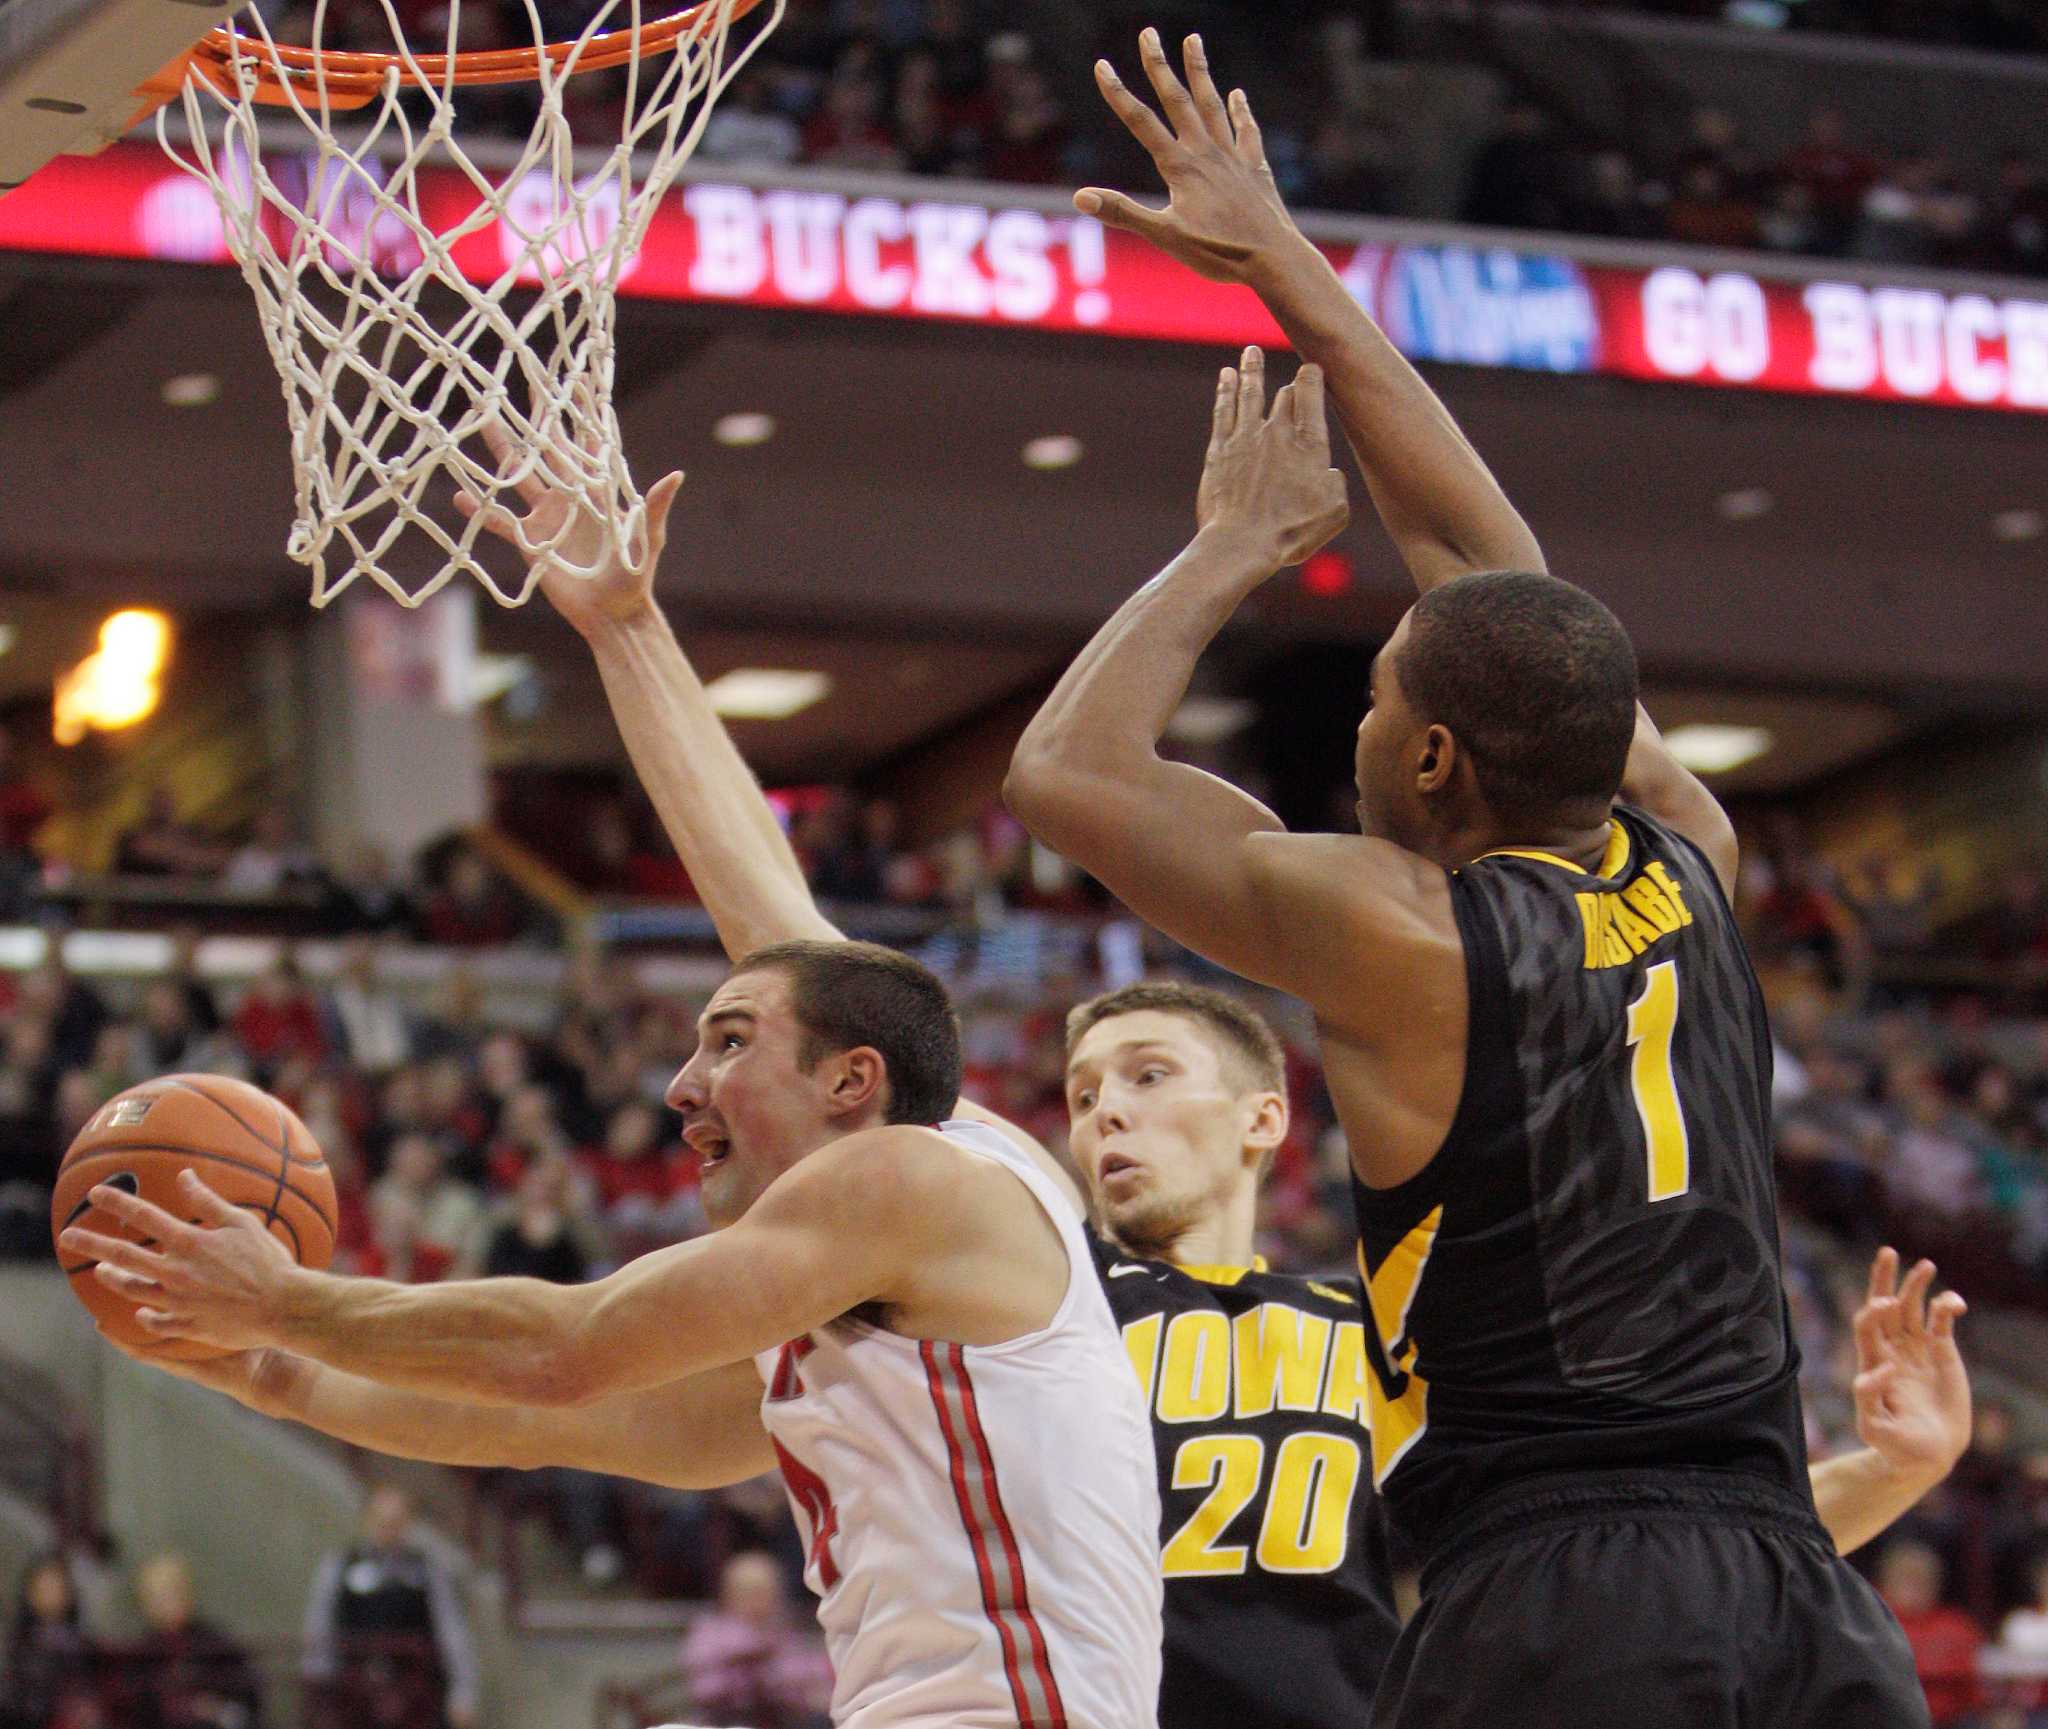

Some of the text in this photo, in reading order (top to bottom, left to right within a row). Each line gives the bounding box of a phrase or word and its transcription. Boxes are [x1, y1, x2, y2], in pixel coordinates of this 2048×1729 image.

[684, 183, 1111, 326] BUCKS!
[1641, 266, 1770, 382] GO
[1625, 960, 1690, 1202] 1
[1121, 1302, 1370, 1431] IOWA
[1160, 1431, 1361, 1578] 20
